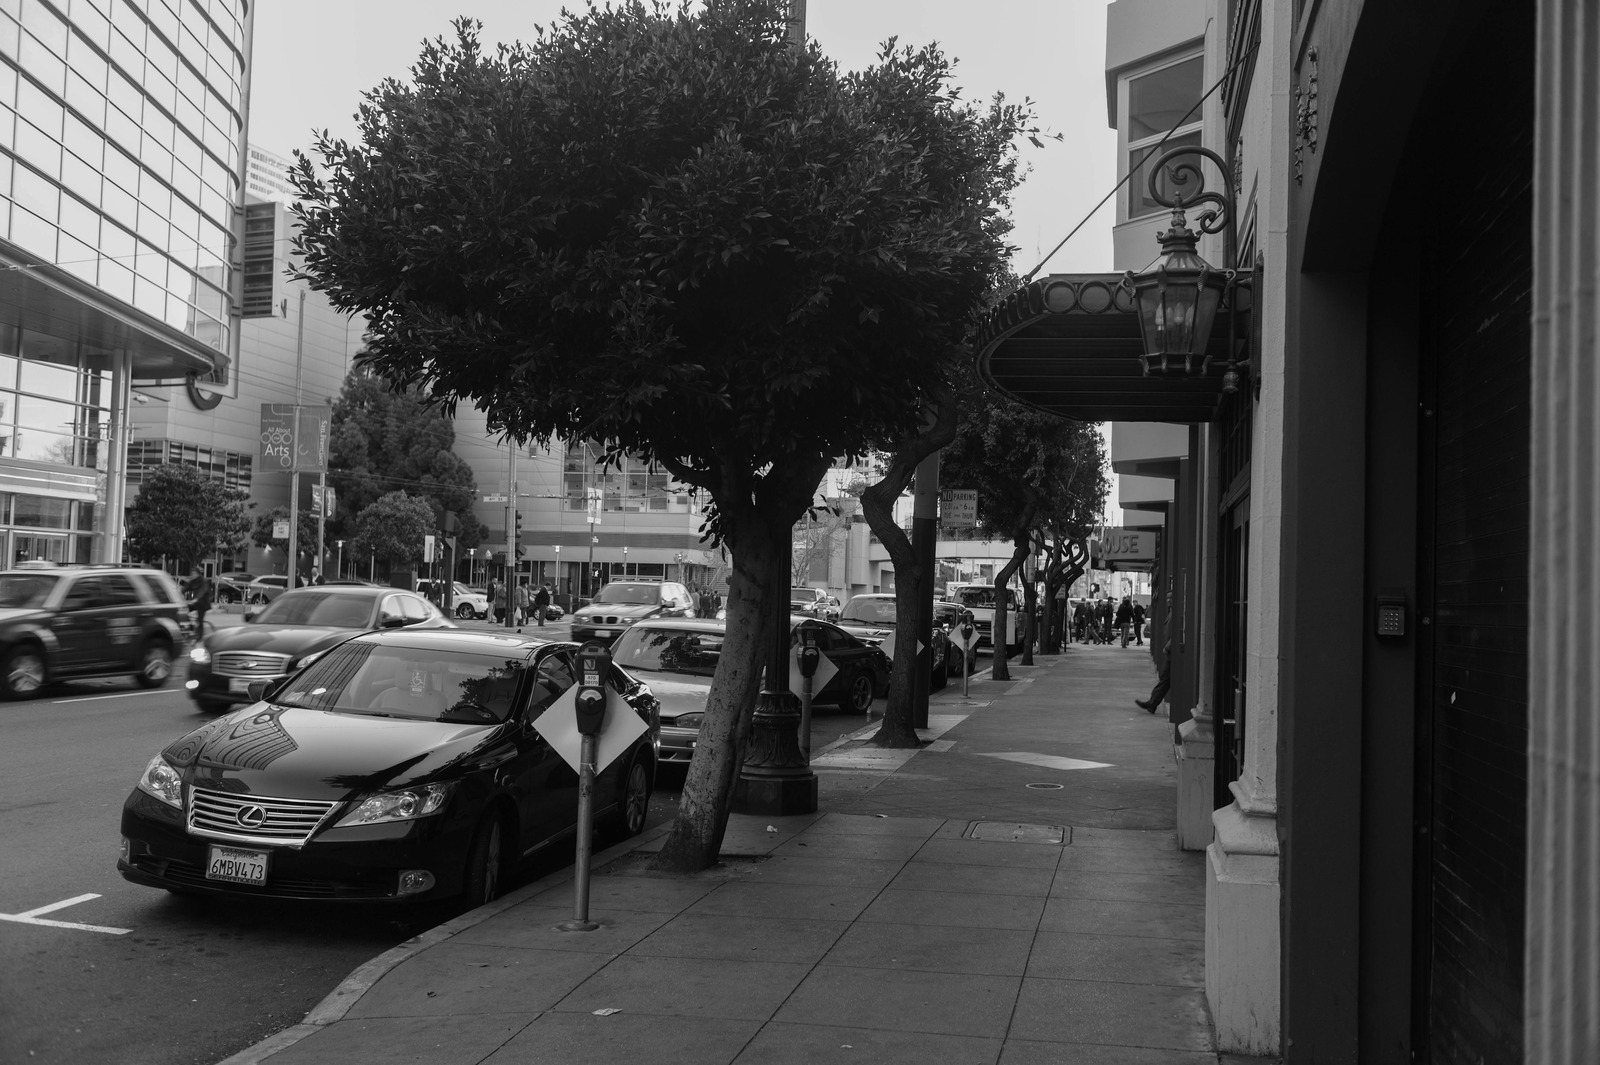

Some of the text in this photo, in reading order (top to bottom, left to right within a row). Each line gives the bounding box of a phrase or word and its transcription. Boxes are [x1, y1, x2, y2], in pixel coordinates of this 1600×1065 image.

[275, 426, 291, 434] About
[264, 443, 290, 457] Arts
[318, 435, 326, 466] Francisco
[942, 490, 952, 500] NO
[1104, 535, 1139, 554] OUSE
[212, 859, 264, 880] 6MBV473
